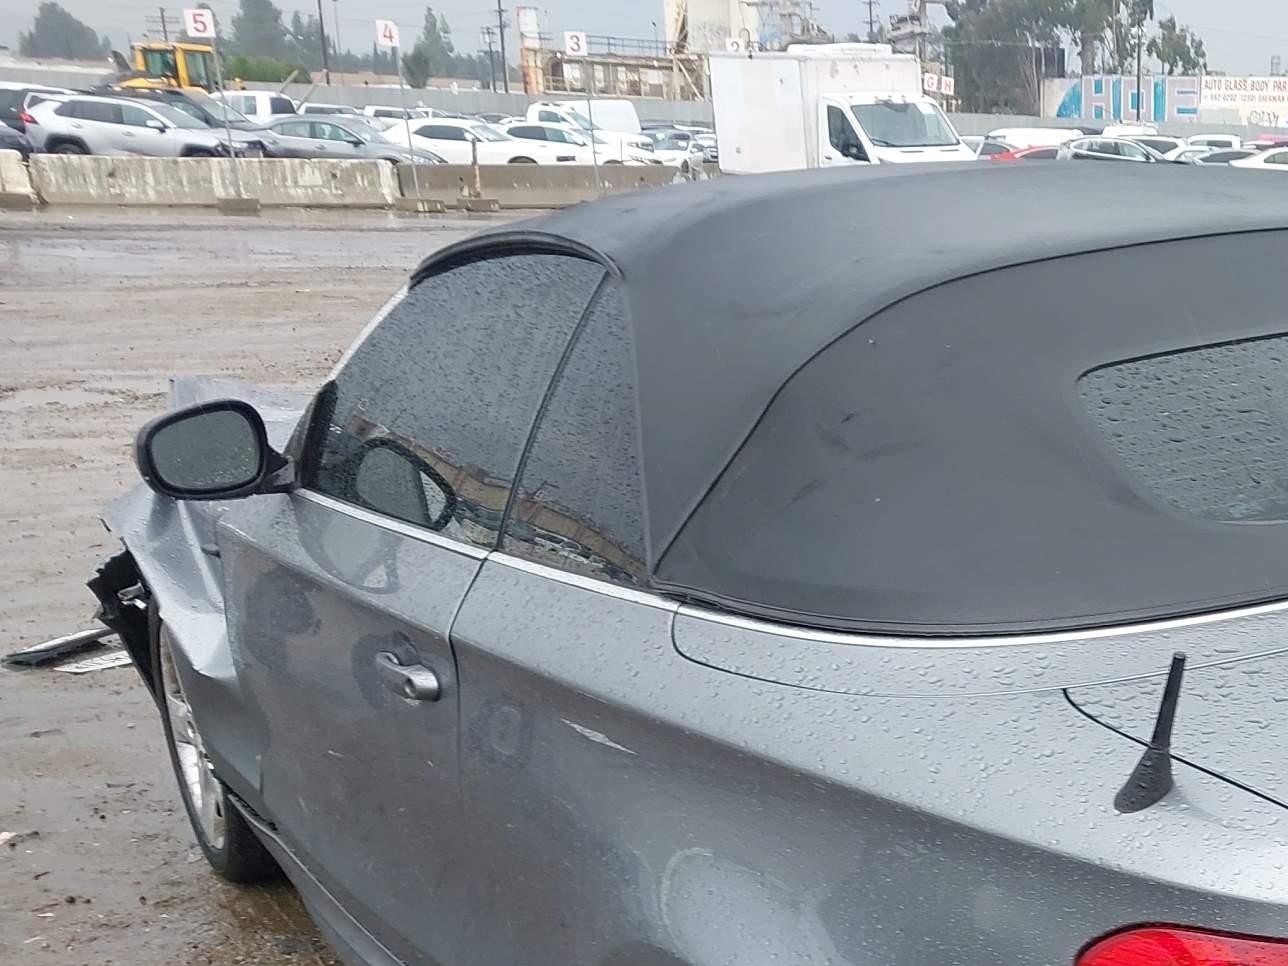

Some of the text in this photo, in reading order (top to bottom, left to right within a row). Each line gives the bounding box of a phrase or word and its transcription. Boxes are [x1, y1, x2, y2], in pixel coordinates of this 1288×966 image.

[191, 13, 208, 33] 5
[382, 23, 395, 43] 4
[569, 34, 581, 52] 3
[943, 79, 953, 93] H
[1204, 78, 1222, 91] AUTO
